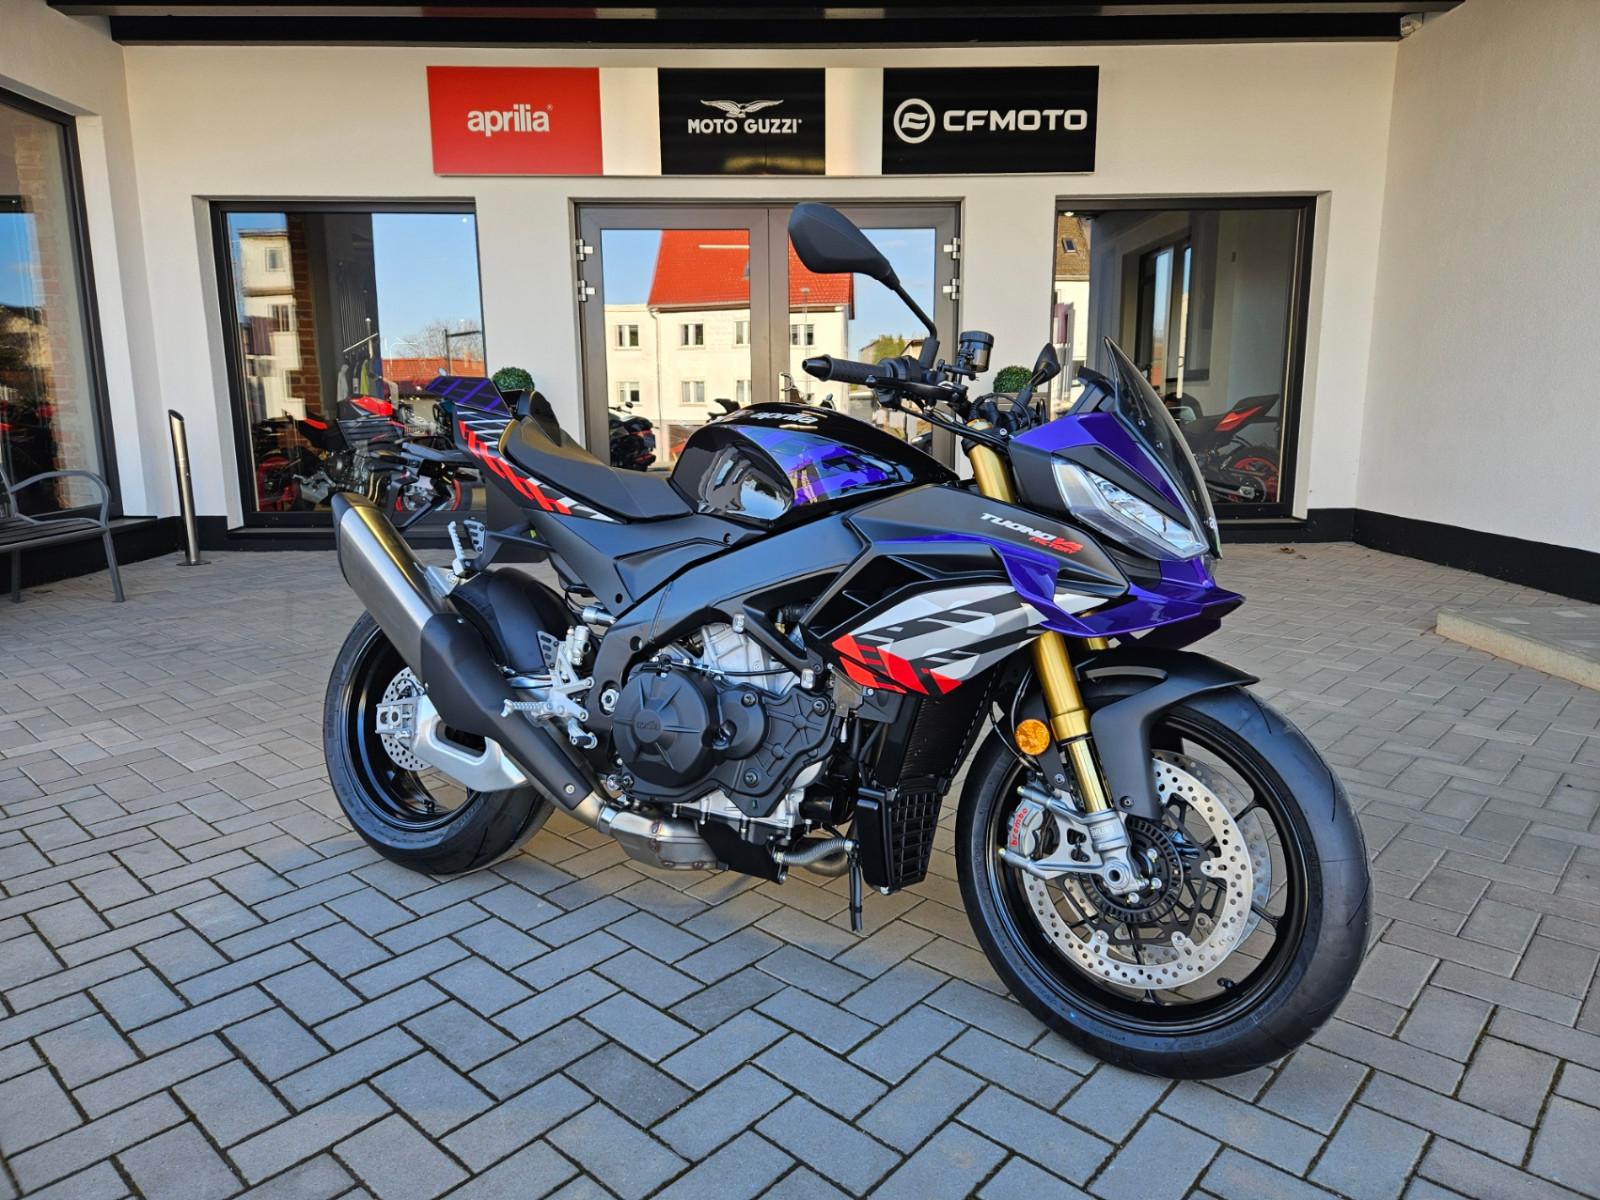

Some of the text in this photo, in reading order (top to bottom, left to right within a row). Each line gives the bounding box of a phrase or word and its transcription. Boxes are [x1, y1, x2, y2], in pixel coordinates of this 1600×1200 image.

[467, 103, 550, 137] aprilia
[687, 118, 798, 134] MOTO GUZZI
[943, 109, 1088, 132] CFMOTO
[1009, 807, 1028, 848] brembo
